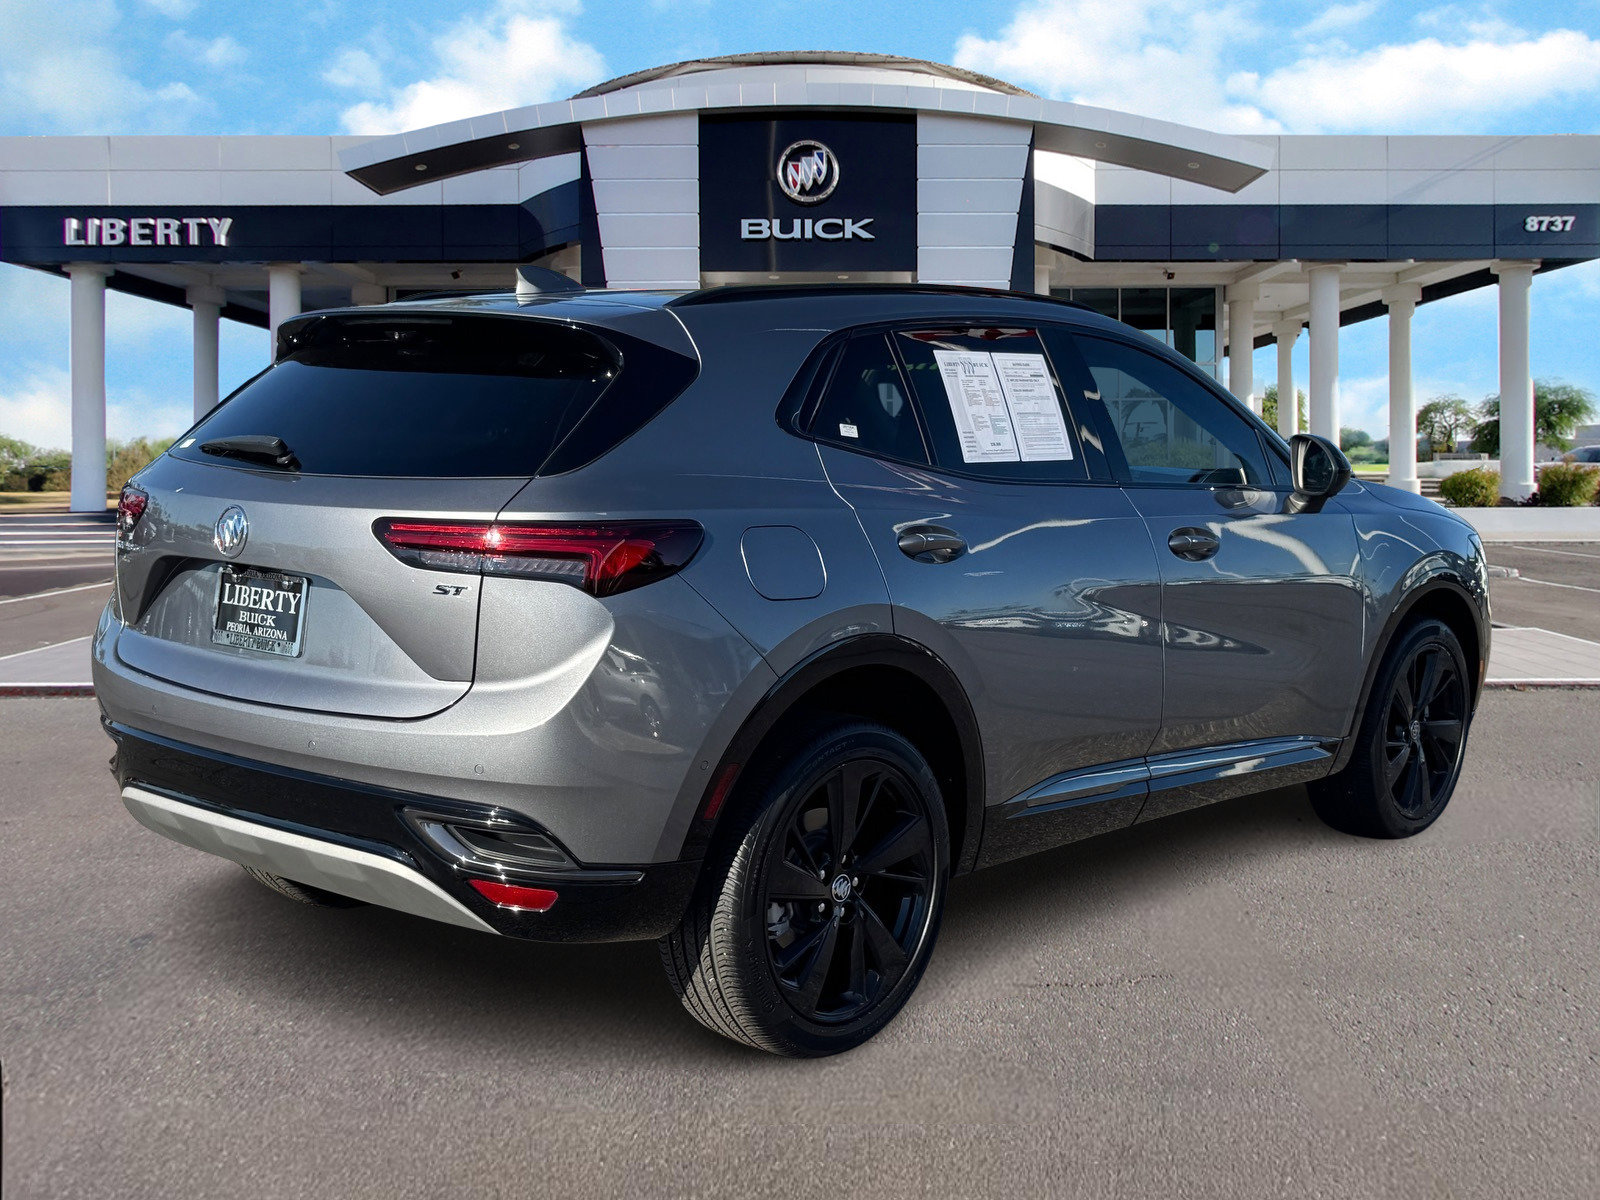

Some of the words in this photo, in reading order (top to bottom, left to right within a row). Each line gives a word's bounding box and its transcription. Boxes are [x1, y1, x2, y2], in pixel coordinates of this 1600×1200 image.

[64, 217, 233, 247] LIBERTY
[741, 218, 876, 240] BUICK
[1524, 215, 1576, 232] 8737
[223, 583, 301, 615] LIBERTY
[432, 584, 469, 596] ST
[238, 611, 276, 626] BUICK
[226, 622, 252, 635] PEORIA,
[253, 628, 287, 640] ARIZONA
